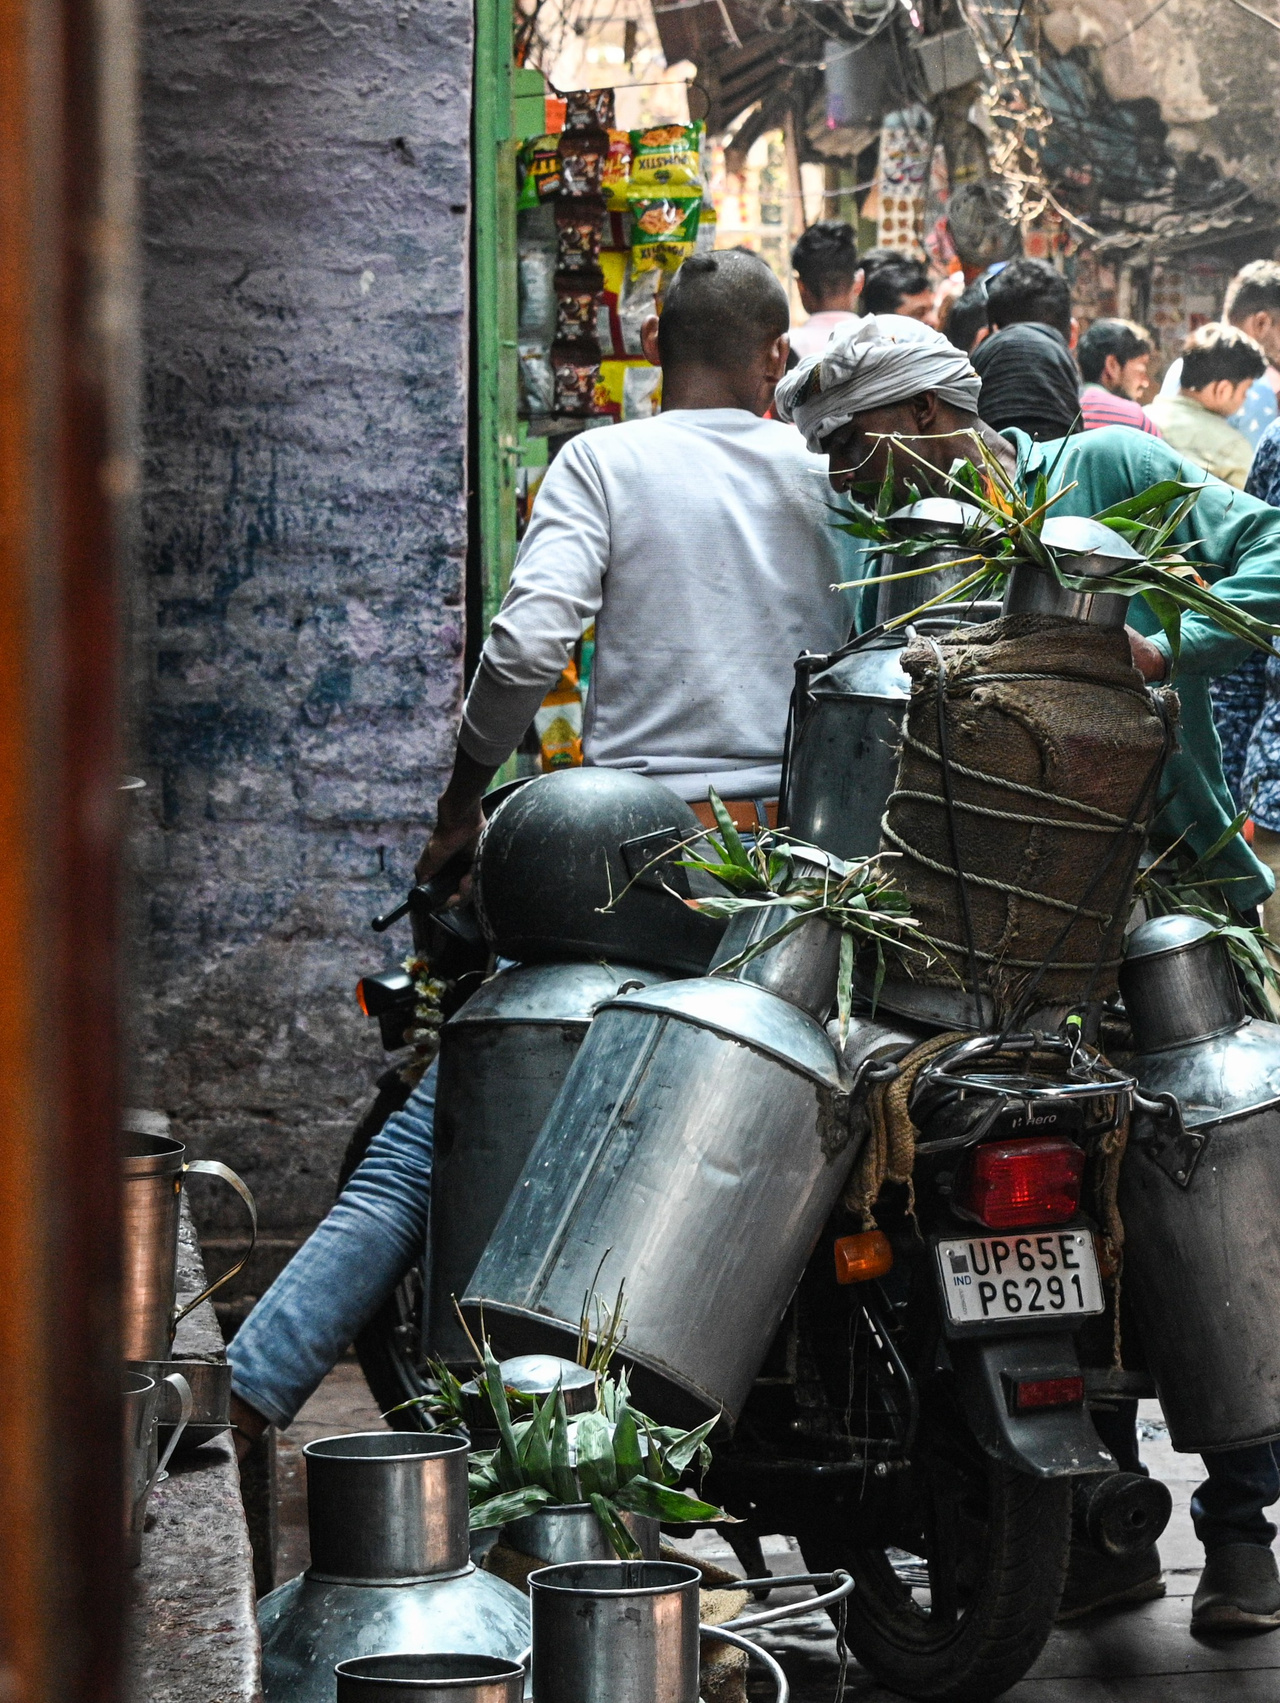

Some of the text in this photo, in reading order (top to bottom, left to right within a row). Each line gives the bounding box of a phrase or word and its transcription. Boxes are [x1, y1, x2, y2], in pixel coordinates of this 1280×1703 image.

[969, 1234, 1080, 1276] UP65E
[953, 1275, 972, 1286] IND
[978, 1273, 1084, 1316] P6291
